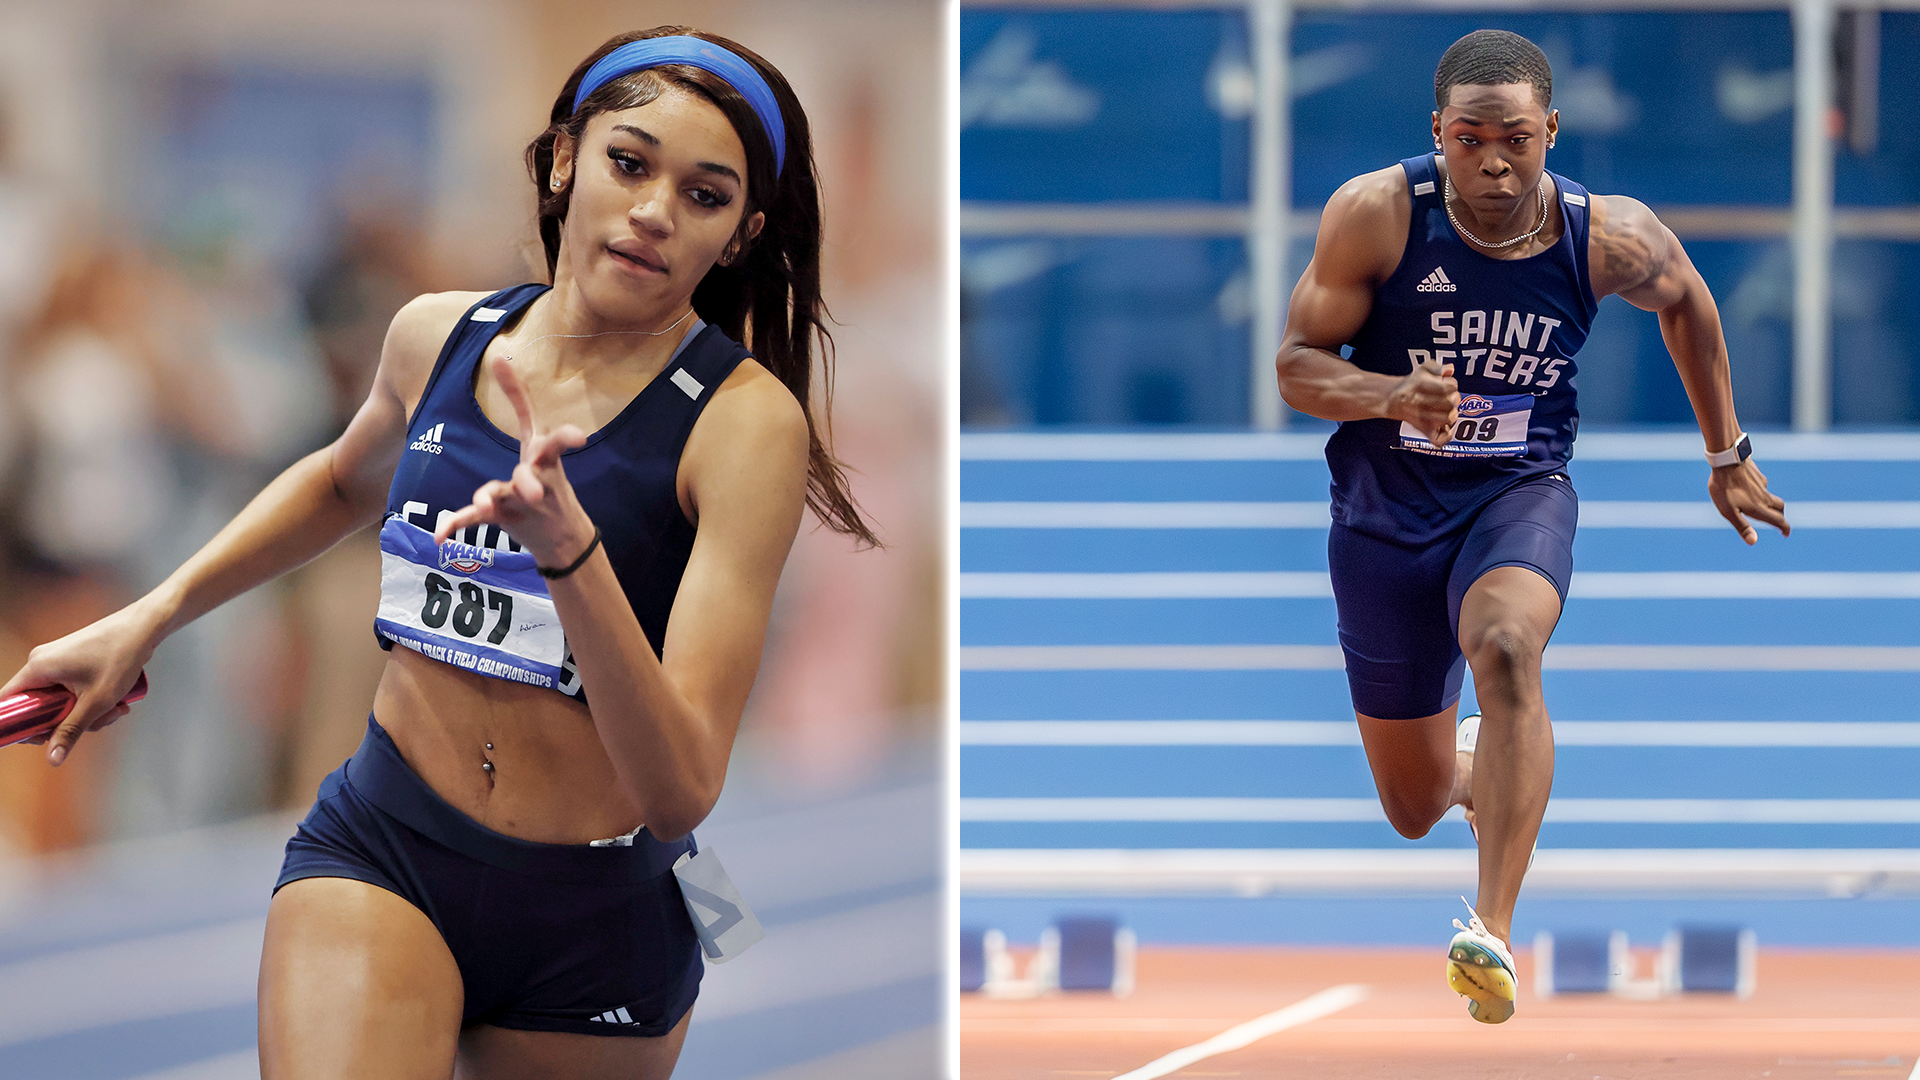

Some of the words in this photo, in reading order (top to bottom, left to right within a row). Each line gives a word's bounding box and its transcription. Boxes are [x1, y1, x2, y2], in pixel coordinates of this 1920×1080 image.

[1416, 282, 1457, 293] adidas
[1431, 310, 1562, 352] SAINT
[1458, 400, 1494, 411] MAAC
[1449, 417, 1500, 441] 09
[409, 439, 444, 455] adidas
[438, 540, 494, 570] MAAC
[421, 572, 513, 645] 687
[422, 642, 447, 662] TRACK
[446, 648, 454, 664] &
[452, 650, 478, 669] FIELD
[477, 657, 552, 688] CHAMPIONSHIPS
